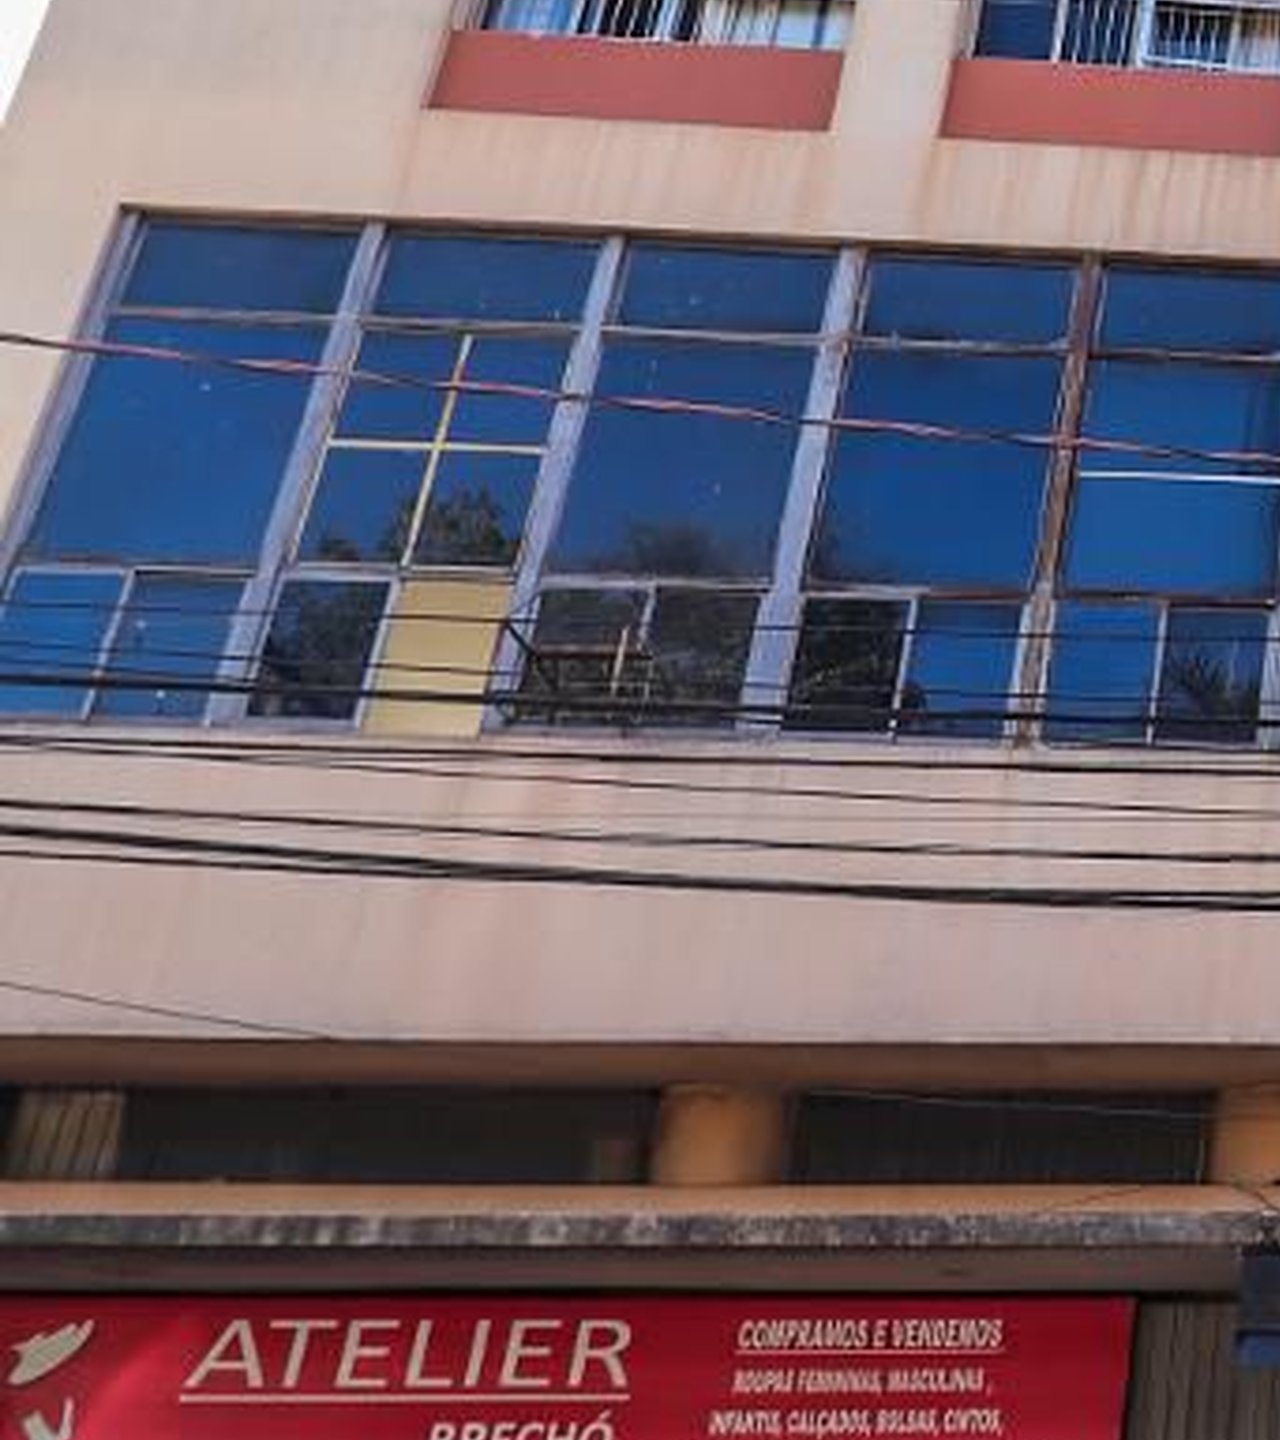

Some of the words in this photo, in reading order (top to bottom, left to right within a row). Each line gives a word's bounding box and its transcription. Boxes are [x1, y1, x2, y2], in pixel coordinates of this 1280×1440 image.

[737, 1319, 868, 1350] COMPRAMOS
[871, 1320, 889, 1349] E
[892, 1319, 1003, 1350] VENDEMOS
[182, 1319, 632, 1389] ATELIER
[732, 1369, 793, 1394] ROUPAS
[786, 1409, 871, 1440] CALÇADOS,
[875, 1410, 941, 1437] BOLSAS,
